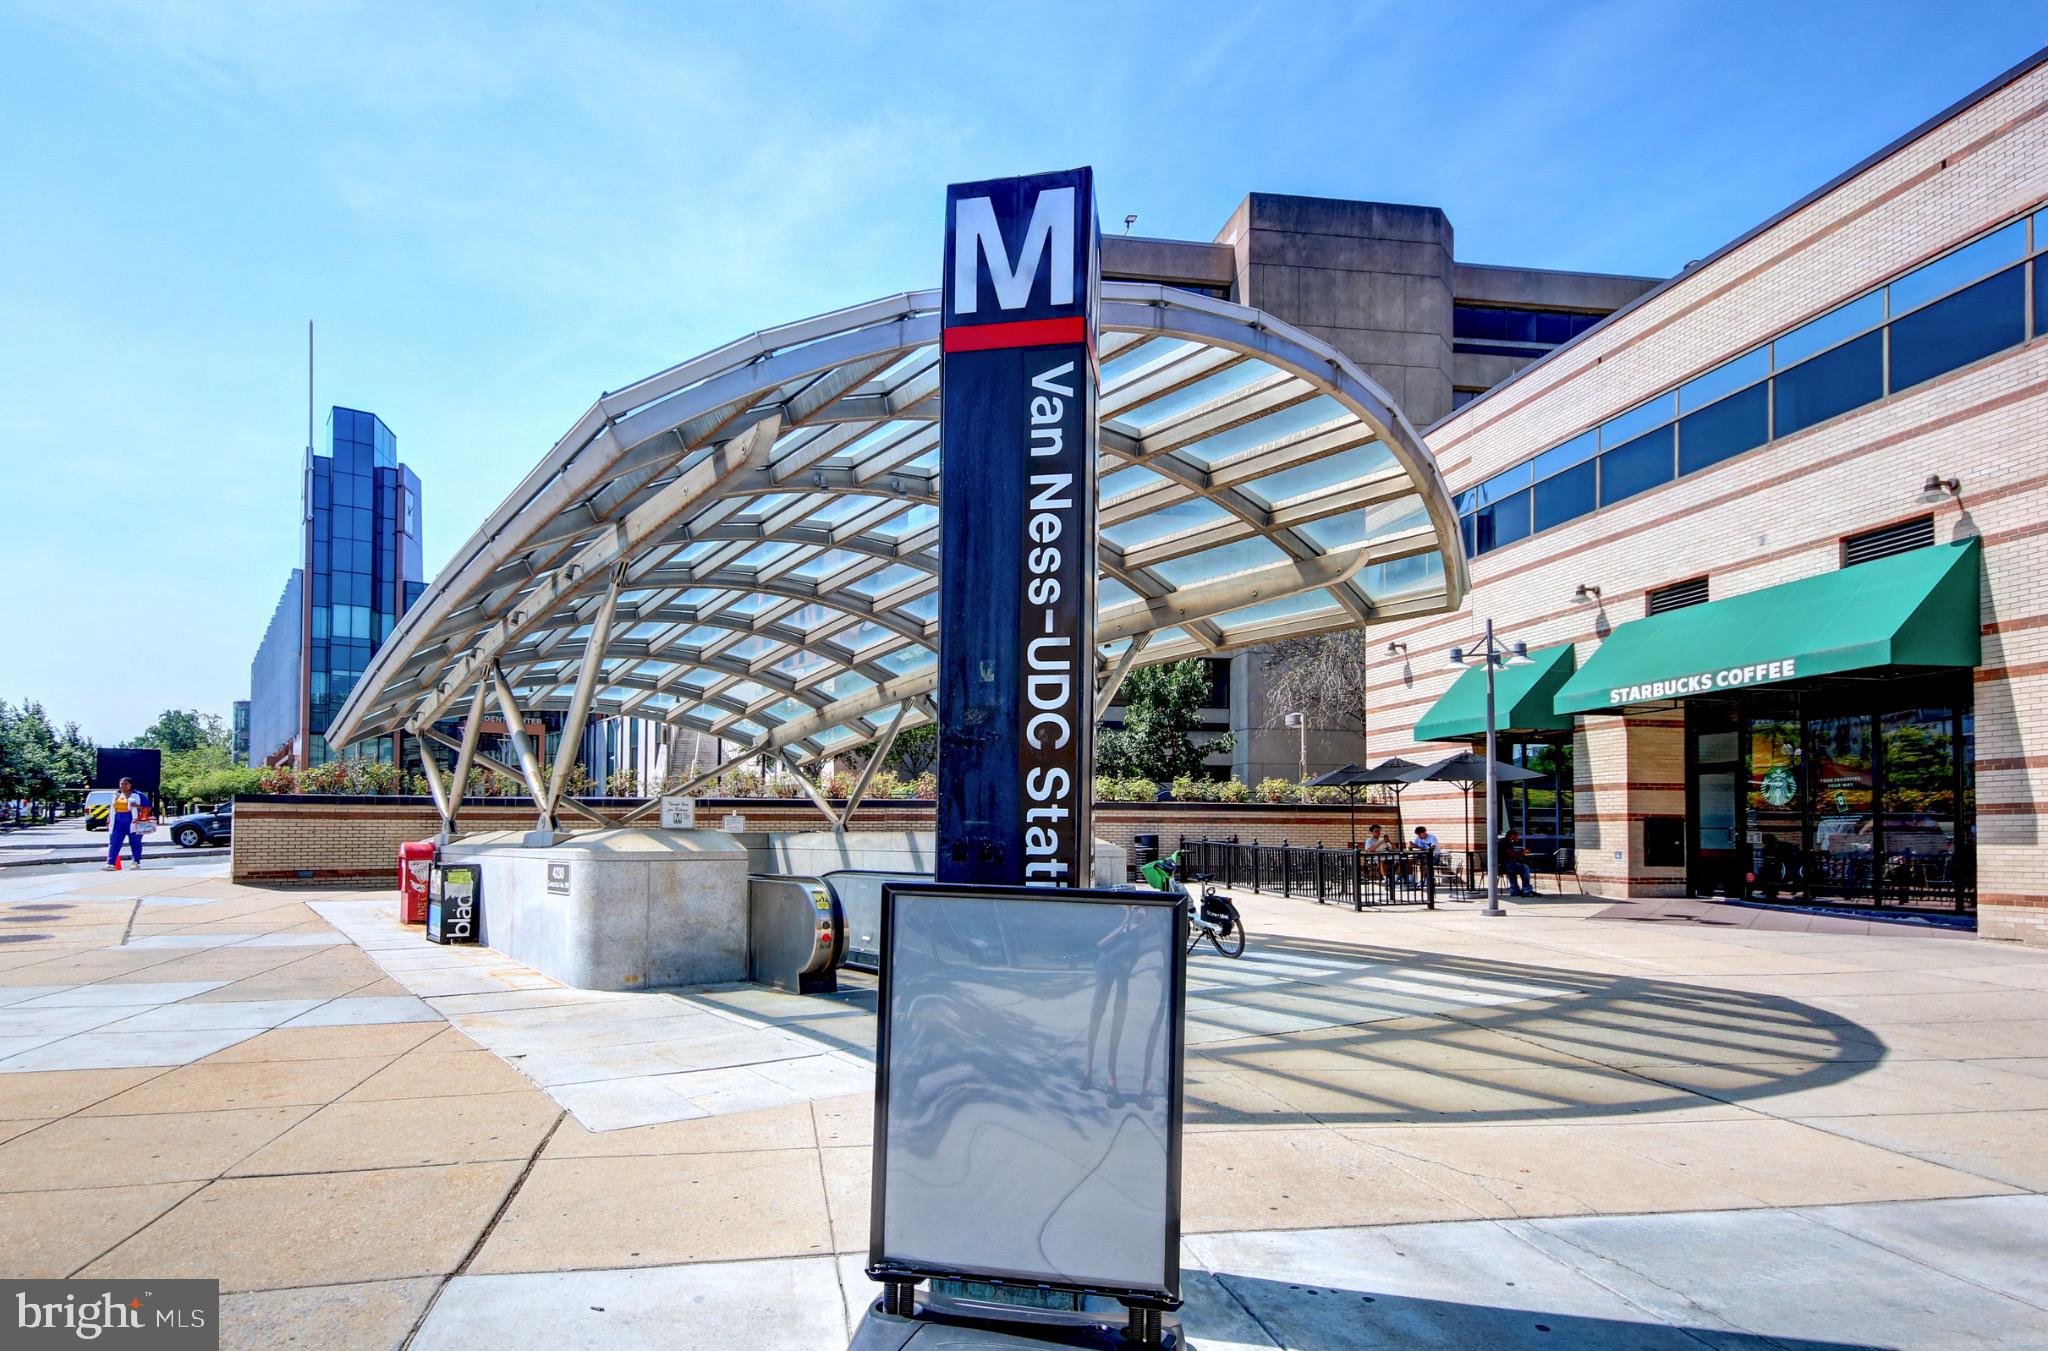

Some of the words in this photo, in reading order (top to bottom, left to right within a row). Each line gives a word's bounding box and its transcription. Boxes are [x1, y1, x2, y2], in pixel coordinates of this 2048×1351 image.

[955, 186, 1075, 315] M
[1030, 360, 1075, 457] Van
[1026, 473, 1073, 750] Ness-UDC
[1610, 673, 1713, 704] STARBUCKS
[1716, 659, 1796, 688] COFFEE
